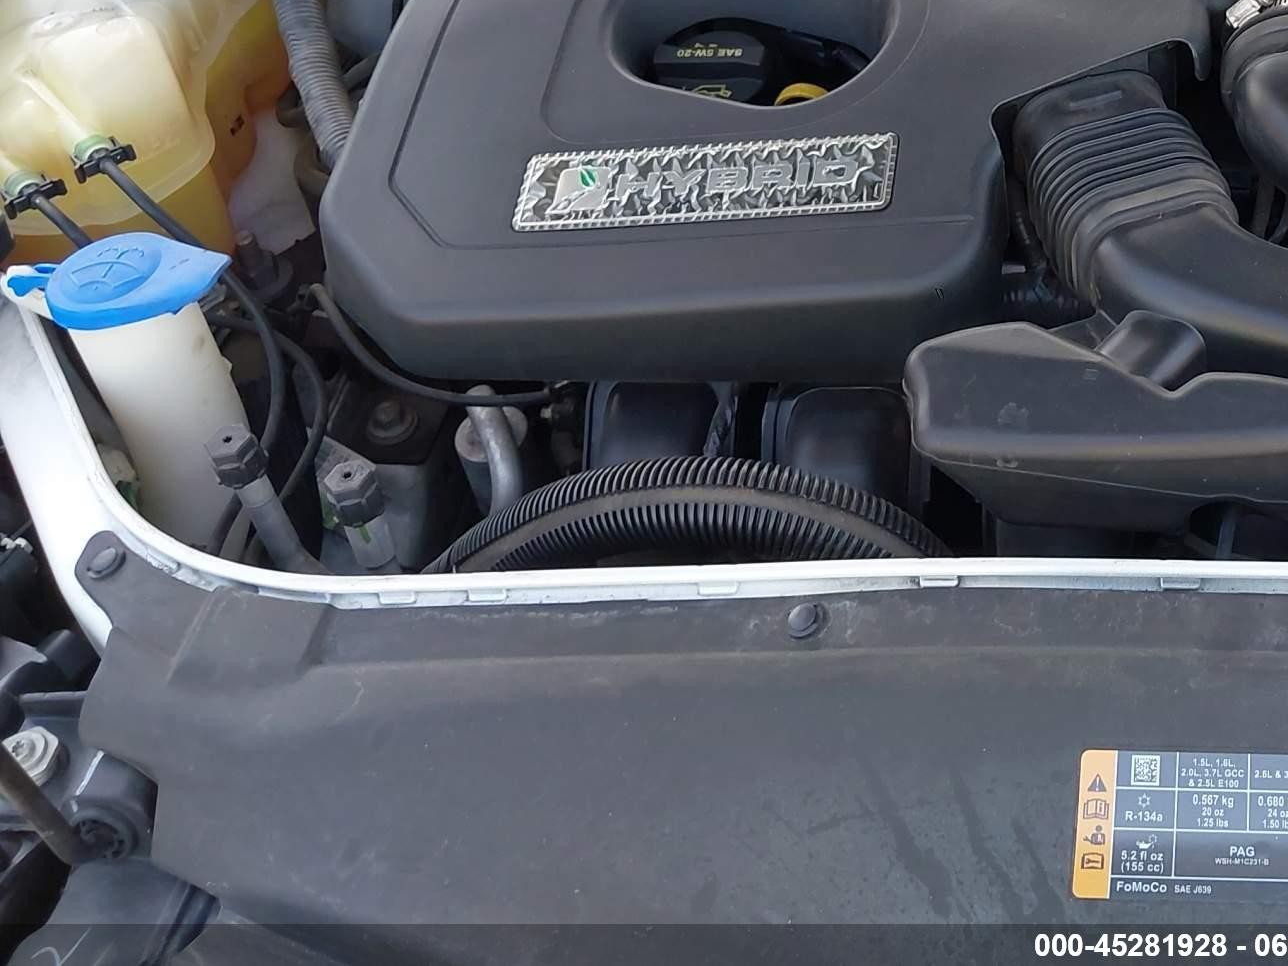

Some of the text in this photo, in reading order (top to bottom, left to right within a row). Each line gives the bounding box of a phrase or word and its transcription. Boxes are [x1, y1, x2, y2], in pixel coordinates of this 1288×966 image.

[676, 48, 743, 58] SAE 5W-20
[616, 157, 858, 197] HYBRID
[1182, 769, 1245, 779] 2.0L, 3.7L GCC
[1275, 770, 1281, 779] &
[1188, 779, 1195, 787] &
[1218, 780, 1239, 788] E100
[1192, 794, 1234, 807] 0.567 kg
[1258, 796, 1285, 807] 0.680
[1125, 810, 1163, 822] R-134a
[1202, 808, 1212, 816] 20
[1268, 810, 1278, 818] 24
[1197, 818, 1229, 828] 1.25 lbs
[1262, 820, 1280, 828] 1.50
[1121, 850, 1164, 861] 5.2 fl oz
[1230, 846, 1255, 857] PAG
[1121, 862, 1164, 874] (155 cc)
[1116, 881, 1212, 894] FoMoCo SAE J639
